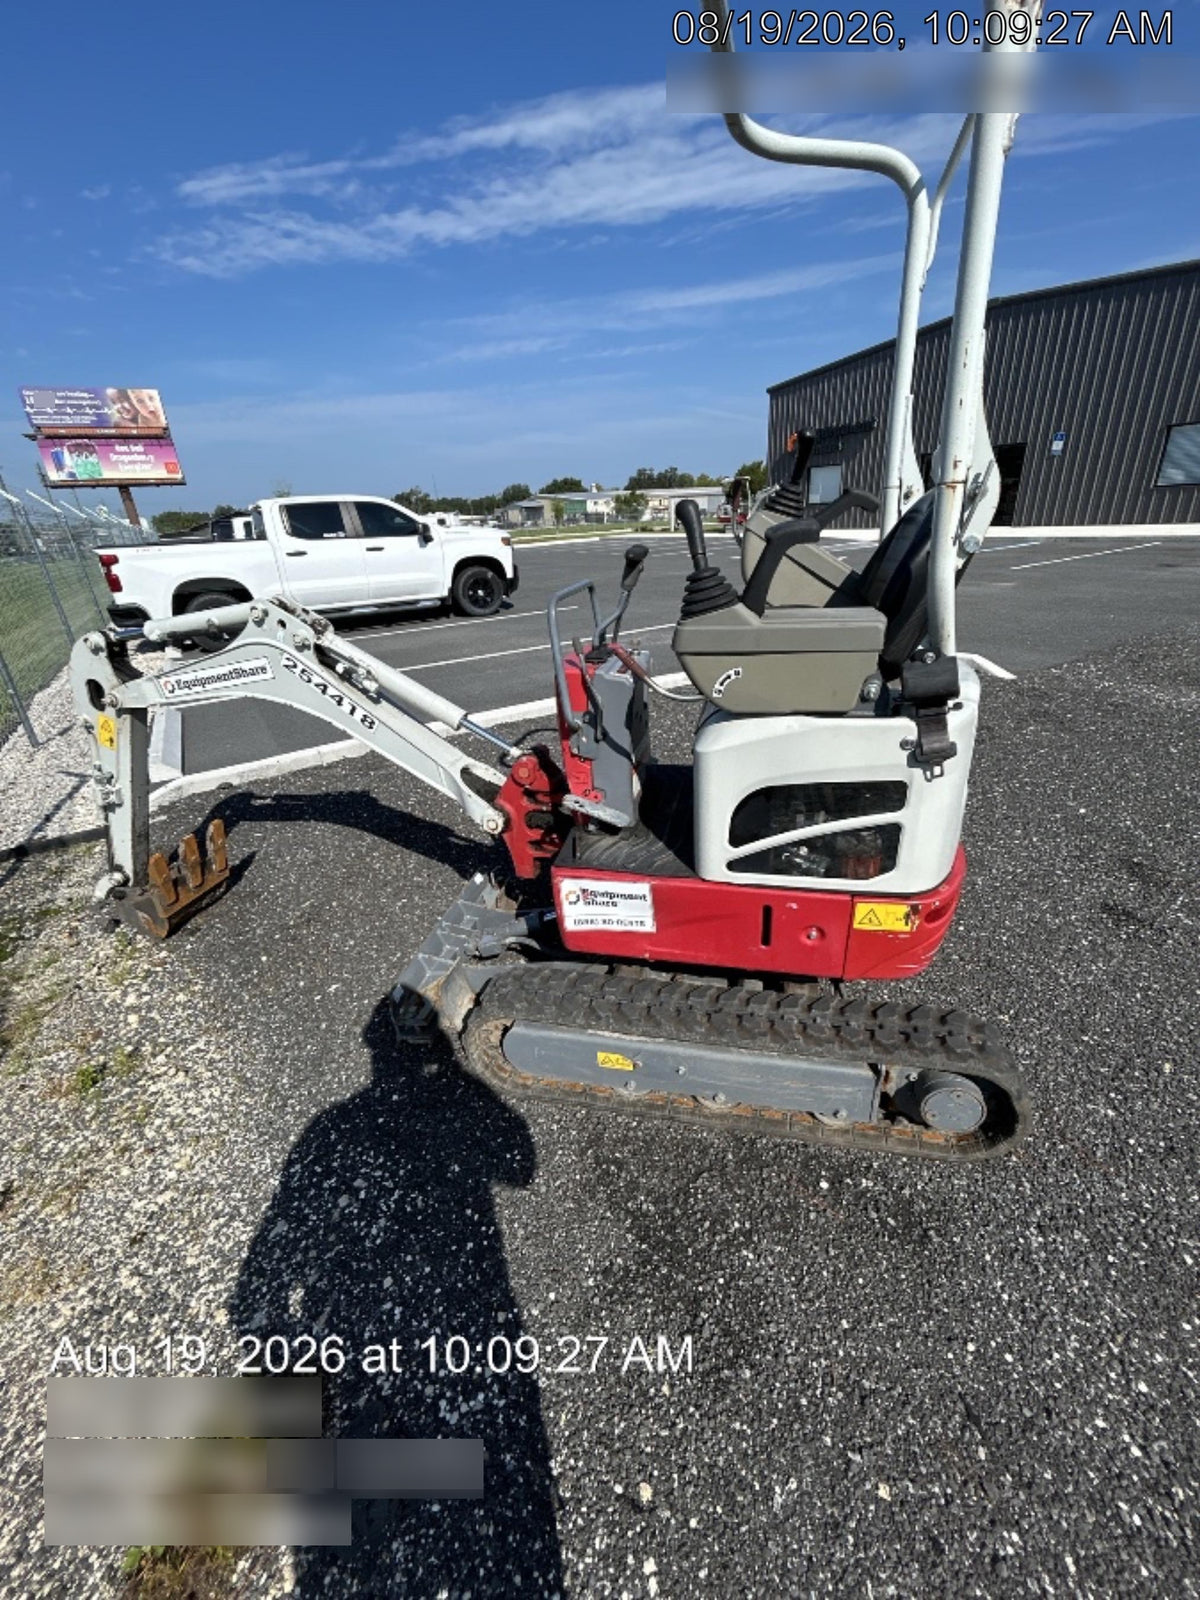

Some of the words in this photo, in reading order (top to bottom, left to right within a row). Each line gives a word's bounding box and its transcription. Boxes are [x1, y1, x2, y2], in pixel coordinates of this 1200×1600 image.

[174, 665, 268, 690] EquipmentShare
[282, 657, 376, 730] 254418
[580, 887, 648, 902] Equipment
